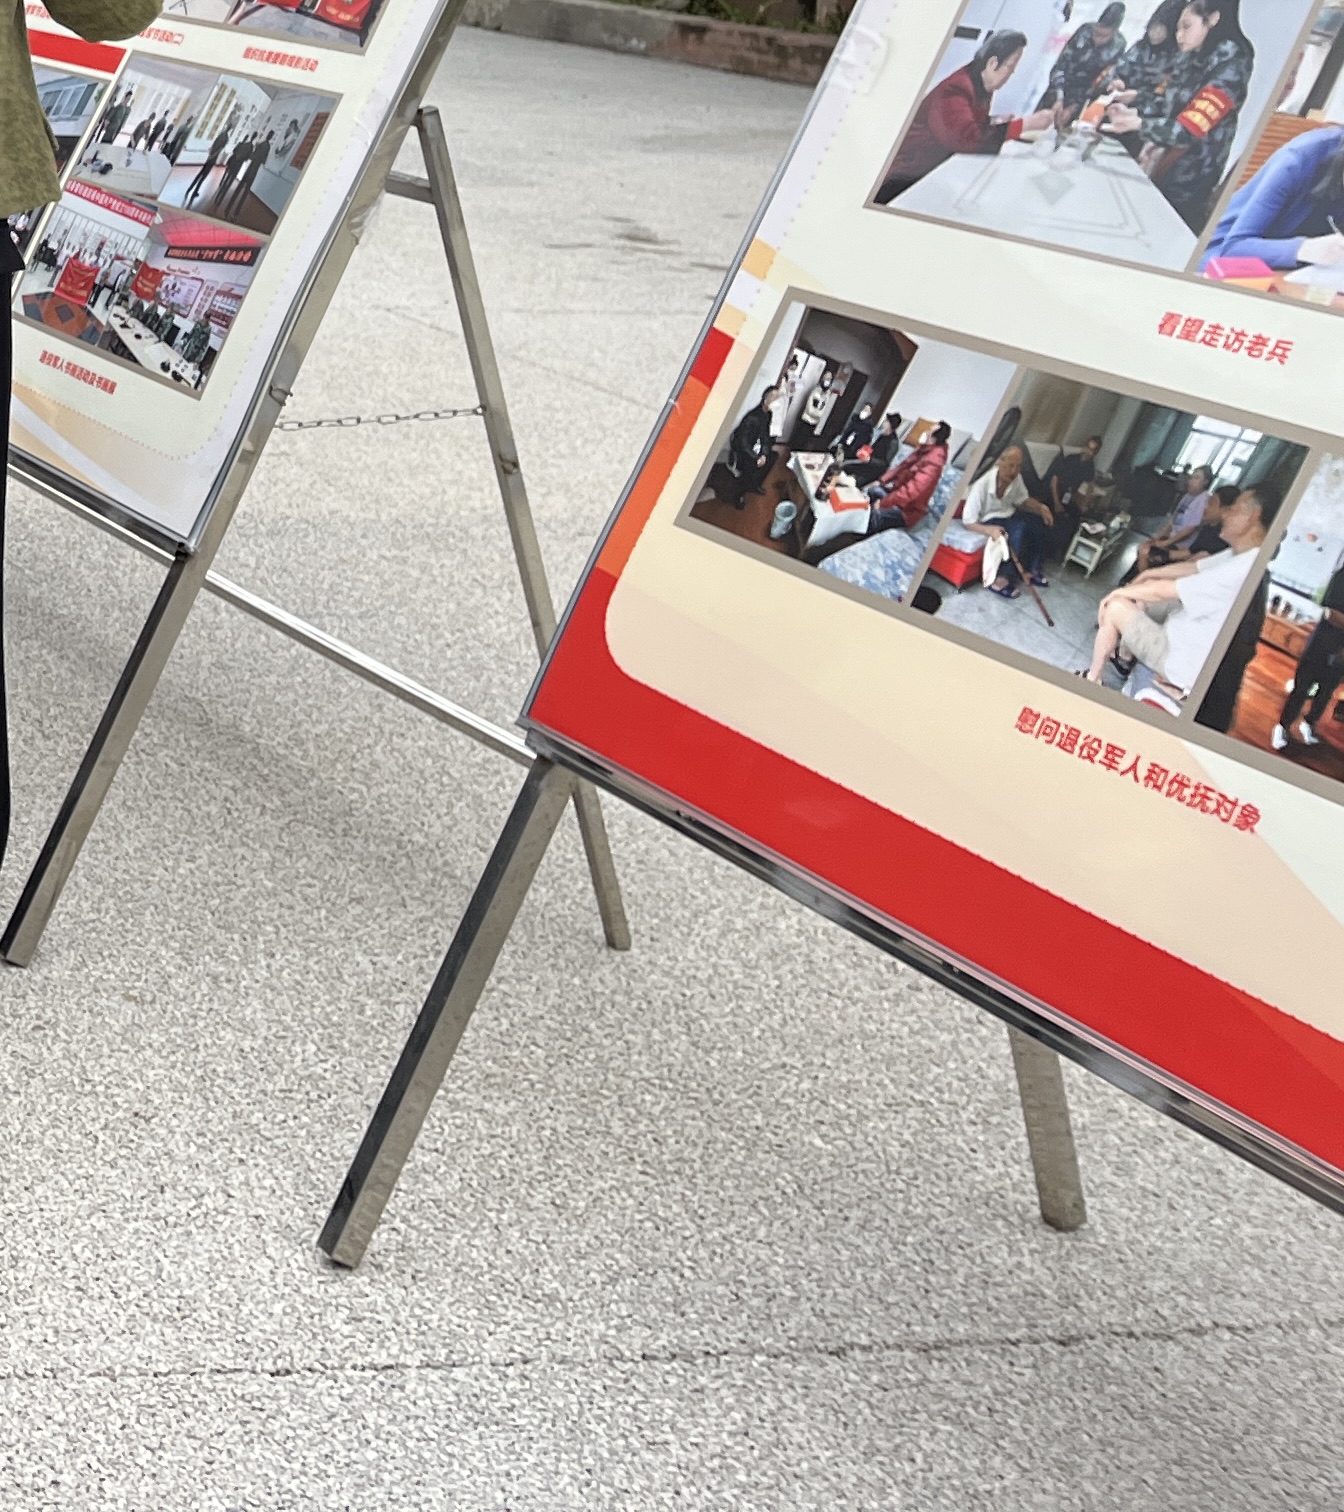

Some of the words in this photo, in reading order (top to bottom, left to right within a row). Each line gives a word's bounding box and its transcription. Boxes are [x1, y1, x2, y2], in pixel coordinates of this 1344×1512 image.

[1158, 311, 1294, 366] 看望走访老兵
[1014, 705, 1262, 835] 慰问退役军人和优抚对象
